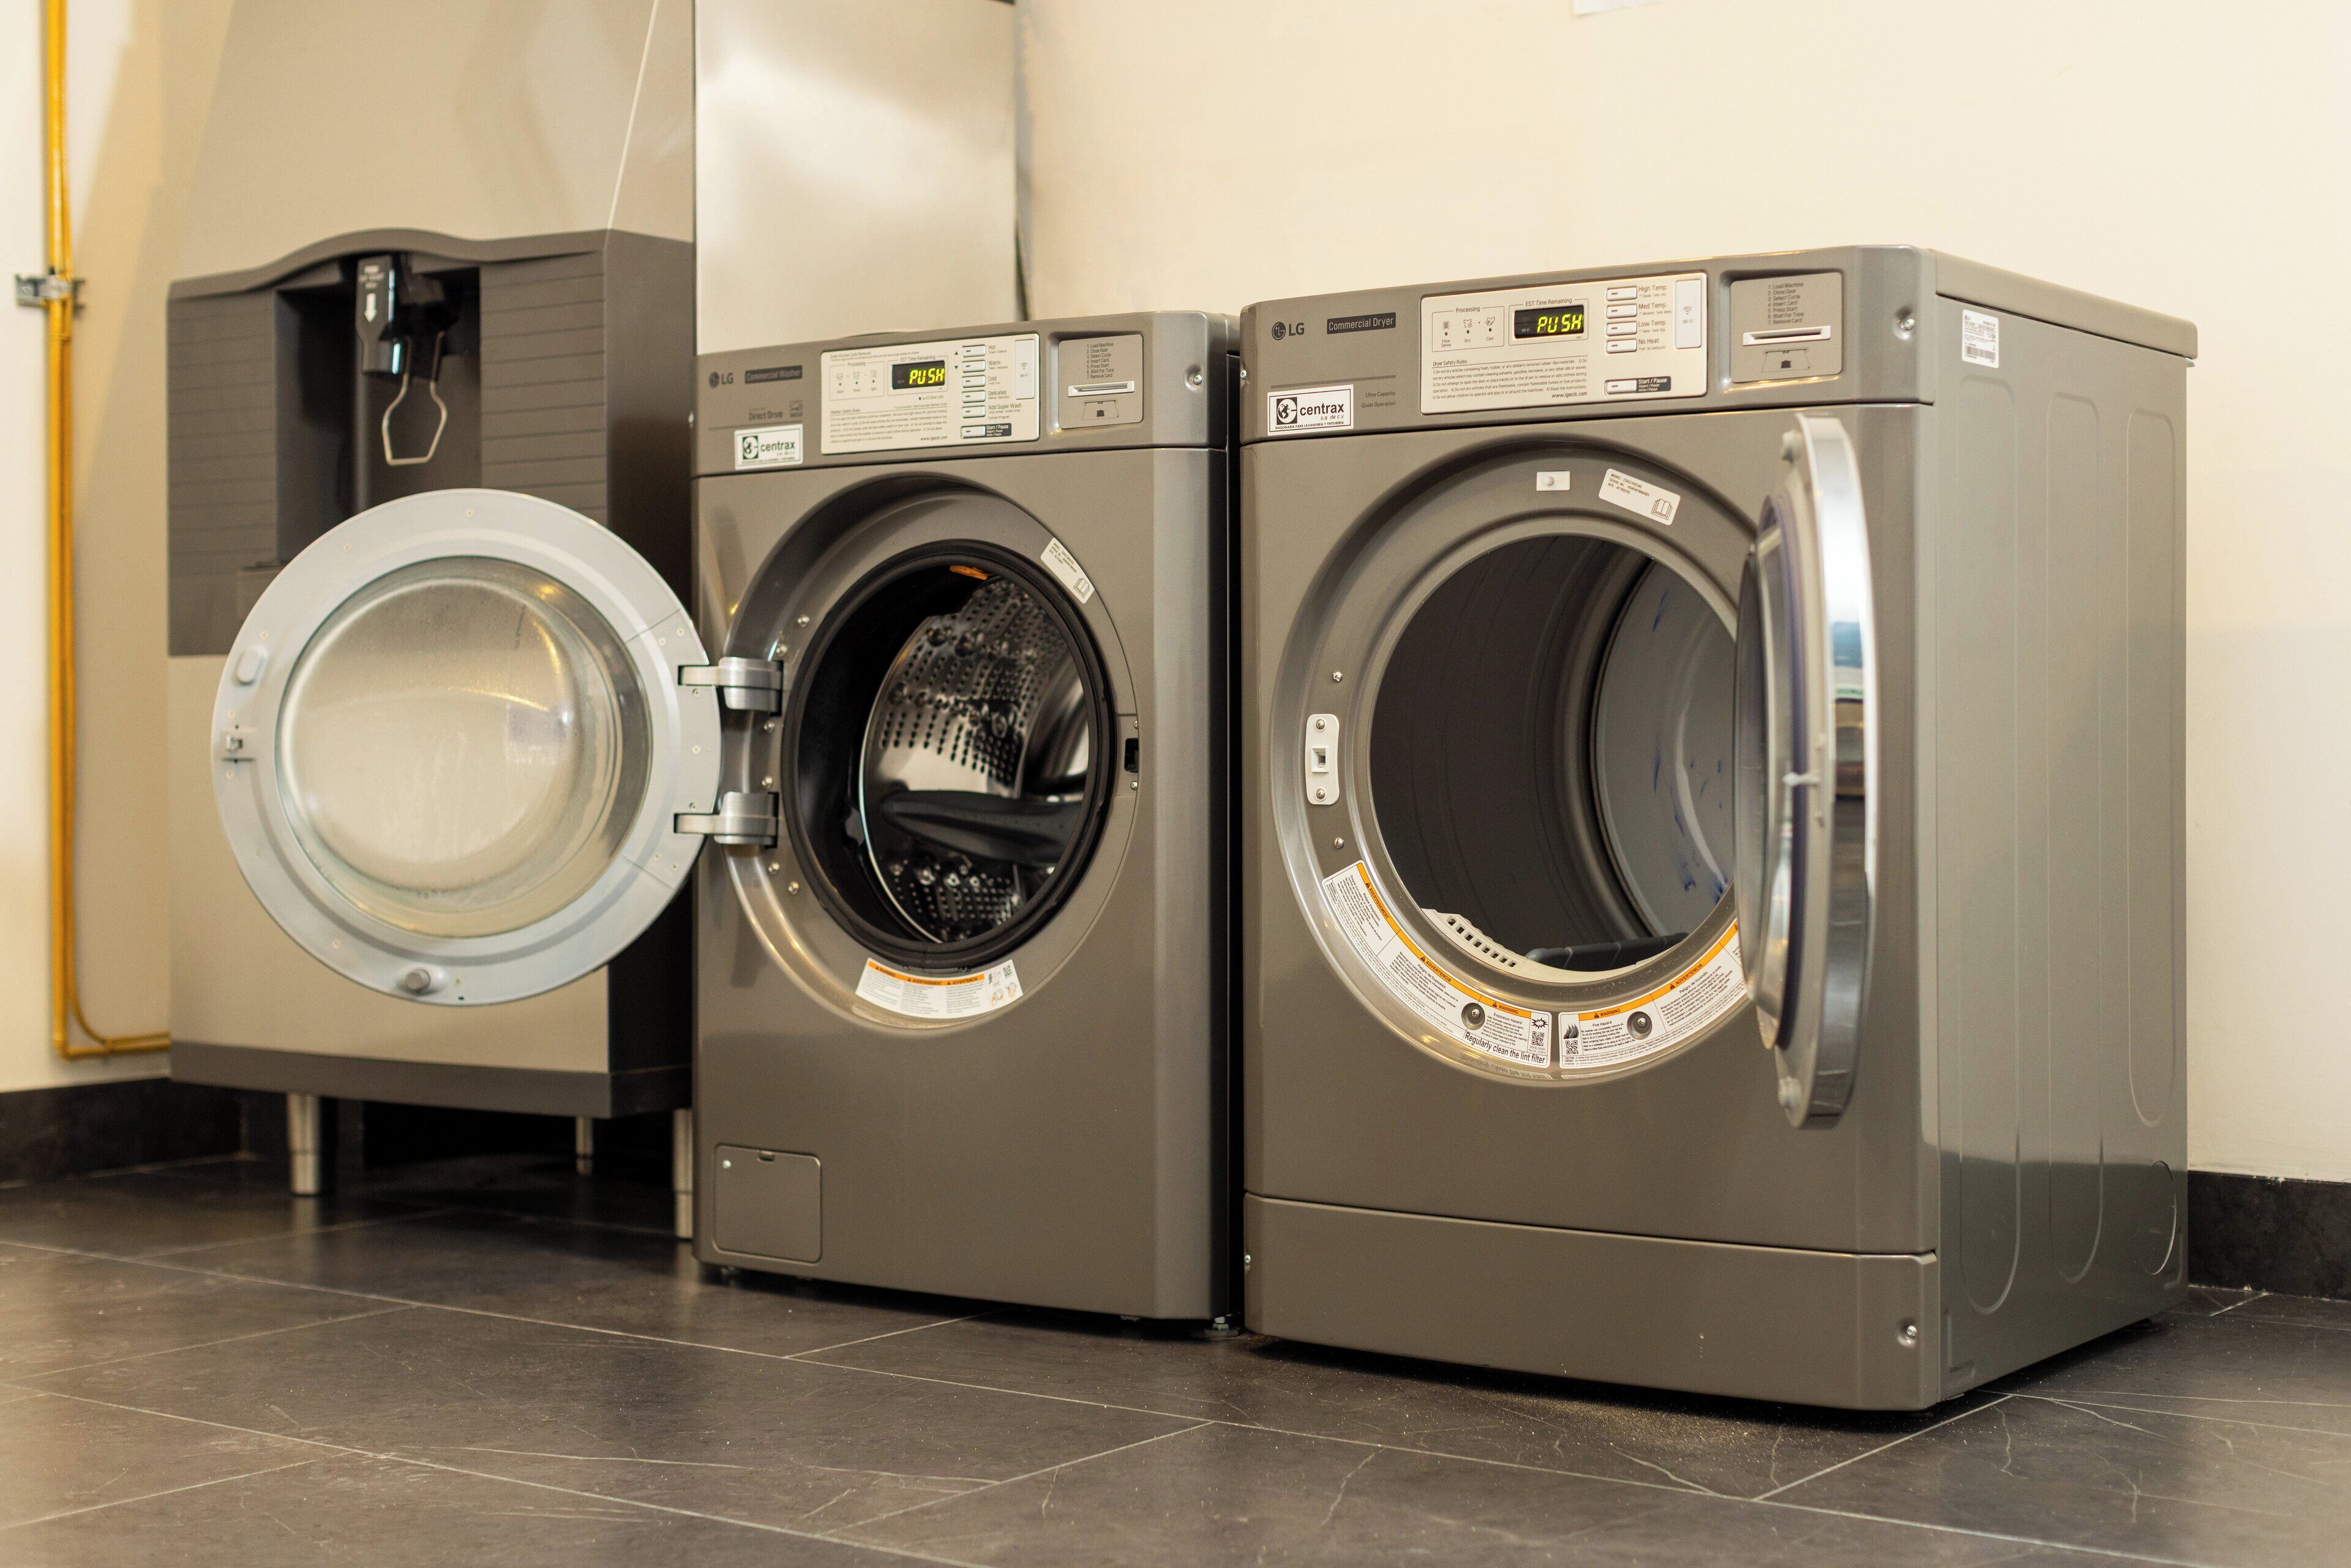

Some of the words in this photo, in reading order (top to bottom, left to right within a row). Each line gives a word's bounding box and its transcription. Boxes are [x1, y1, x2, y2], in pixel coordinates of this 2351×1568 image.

[1289, 322, 1305, 336] LG
[1329, 318, 1371, 331] Commercial
[1373, 317, 1393, 327] Dryer
[1537, 313, 1583, 333] PUSH
[721, 372, 733, 384] LG
[909, 368, 945, 384] PUSH
[1300, 403, 1344, 416] centrax
[760, 441, 795, 452] centrax
[1369, 888, 1390, 919] AVERTISSEMENT
[1417, 964, 1428, 974] Peligro
[1426, 961, 1451, 982] ADVERTENCIA
[1676, 964, 1702, 985] ADVERTENCIA
[1695, 971, 1708, 983] Incendio
[1499, 1004, 1518, 1014] WARNING
[1494, 1013, 1510, 1021] Explosion
[1464, 1032, 1492, 1051] Regularly
[1493, 1045, 1509, 1056] clean
[1509, 1049, 1519, 1059] the
[1521, 1051, 1530, 1061] lint
[1531, 1054, 1545, 1063] filter
